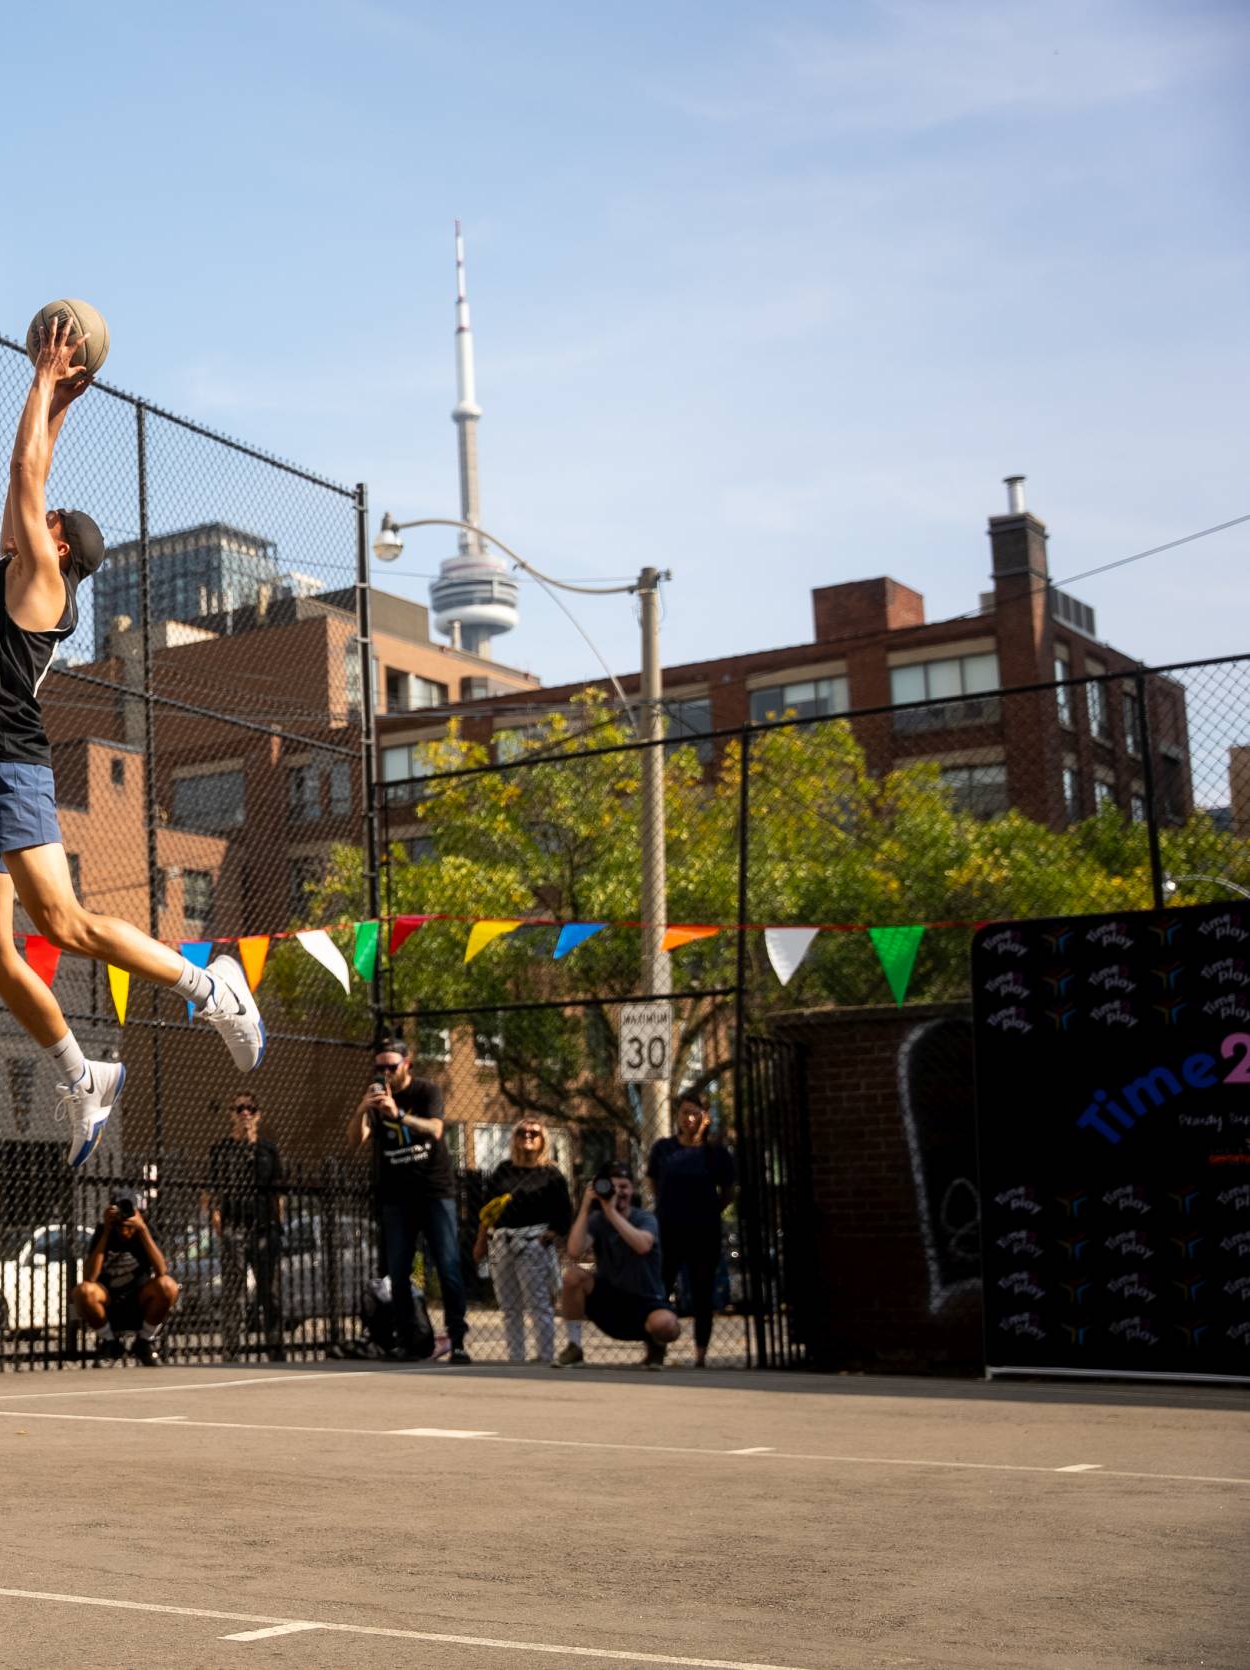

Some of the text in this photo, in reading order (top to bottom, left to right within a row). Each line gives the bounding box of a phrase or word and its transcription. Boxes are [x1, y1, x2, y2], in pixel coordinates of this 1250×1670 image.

[1101, 931, 1135, 950] play
[1214, 922, 1250, 943] play
[997, 939, 1030, 958] play
[1104, 975, 1137, 994] play
[1217, 967, 1250, 988] play
[999, 981, 1031, 1000] play
[623, 1013, 667, 1025] MAXIMUM
[1105, 1009, 1139, 1029] play
[1220, 1003, 1250, 1024] play
[1002, 1016, 1034, 1035] play
[626, 1036, 666, 1069] 30
